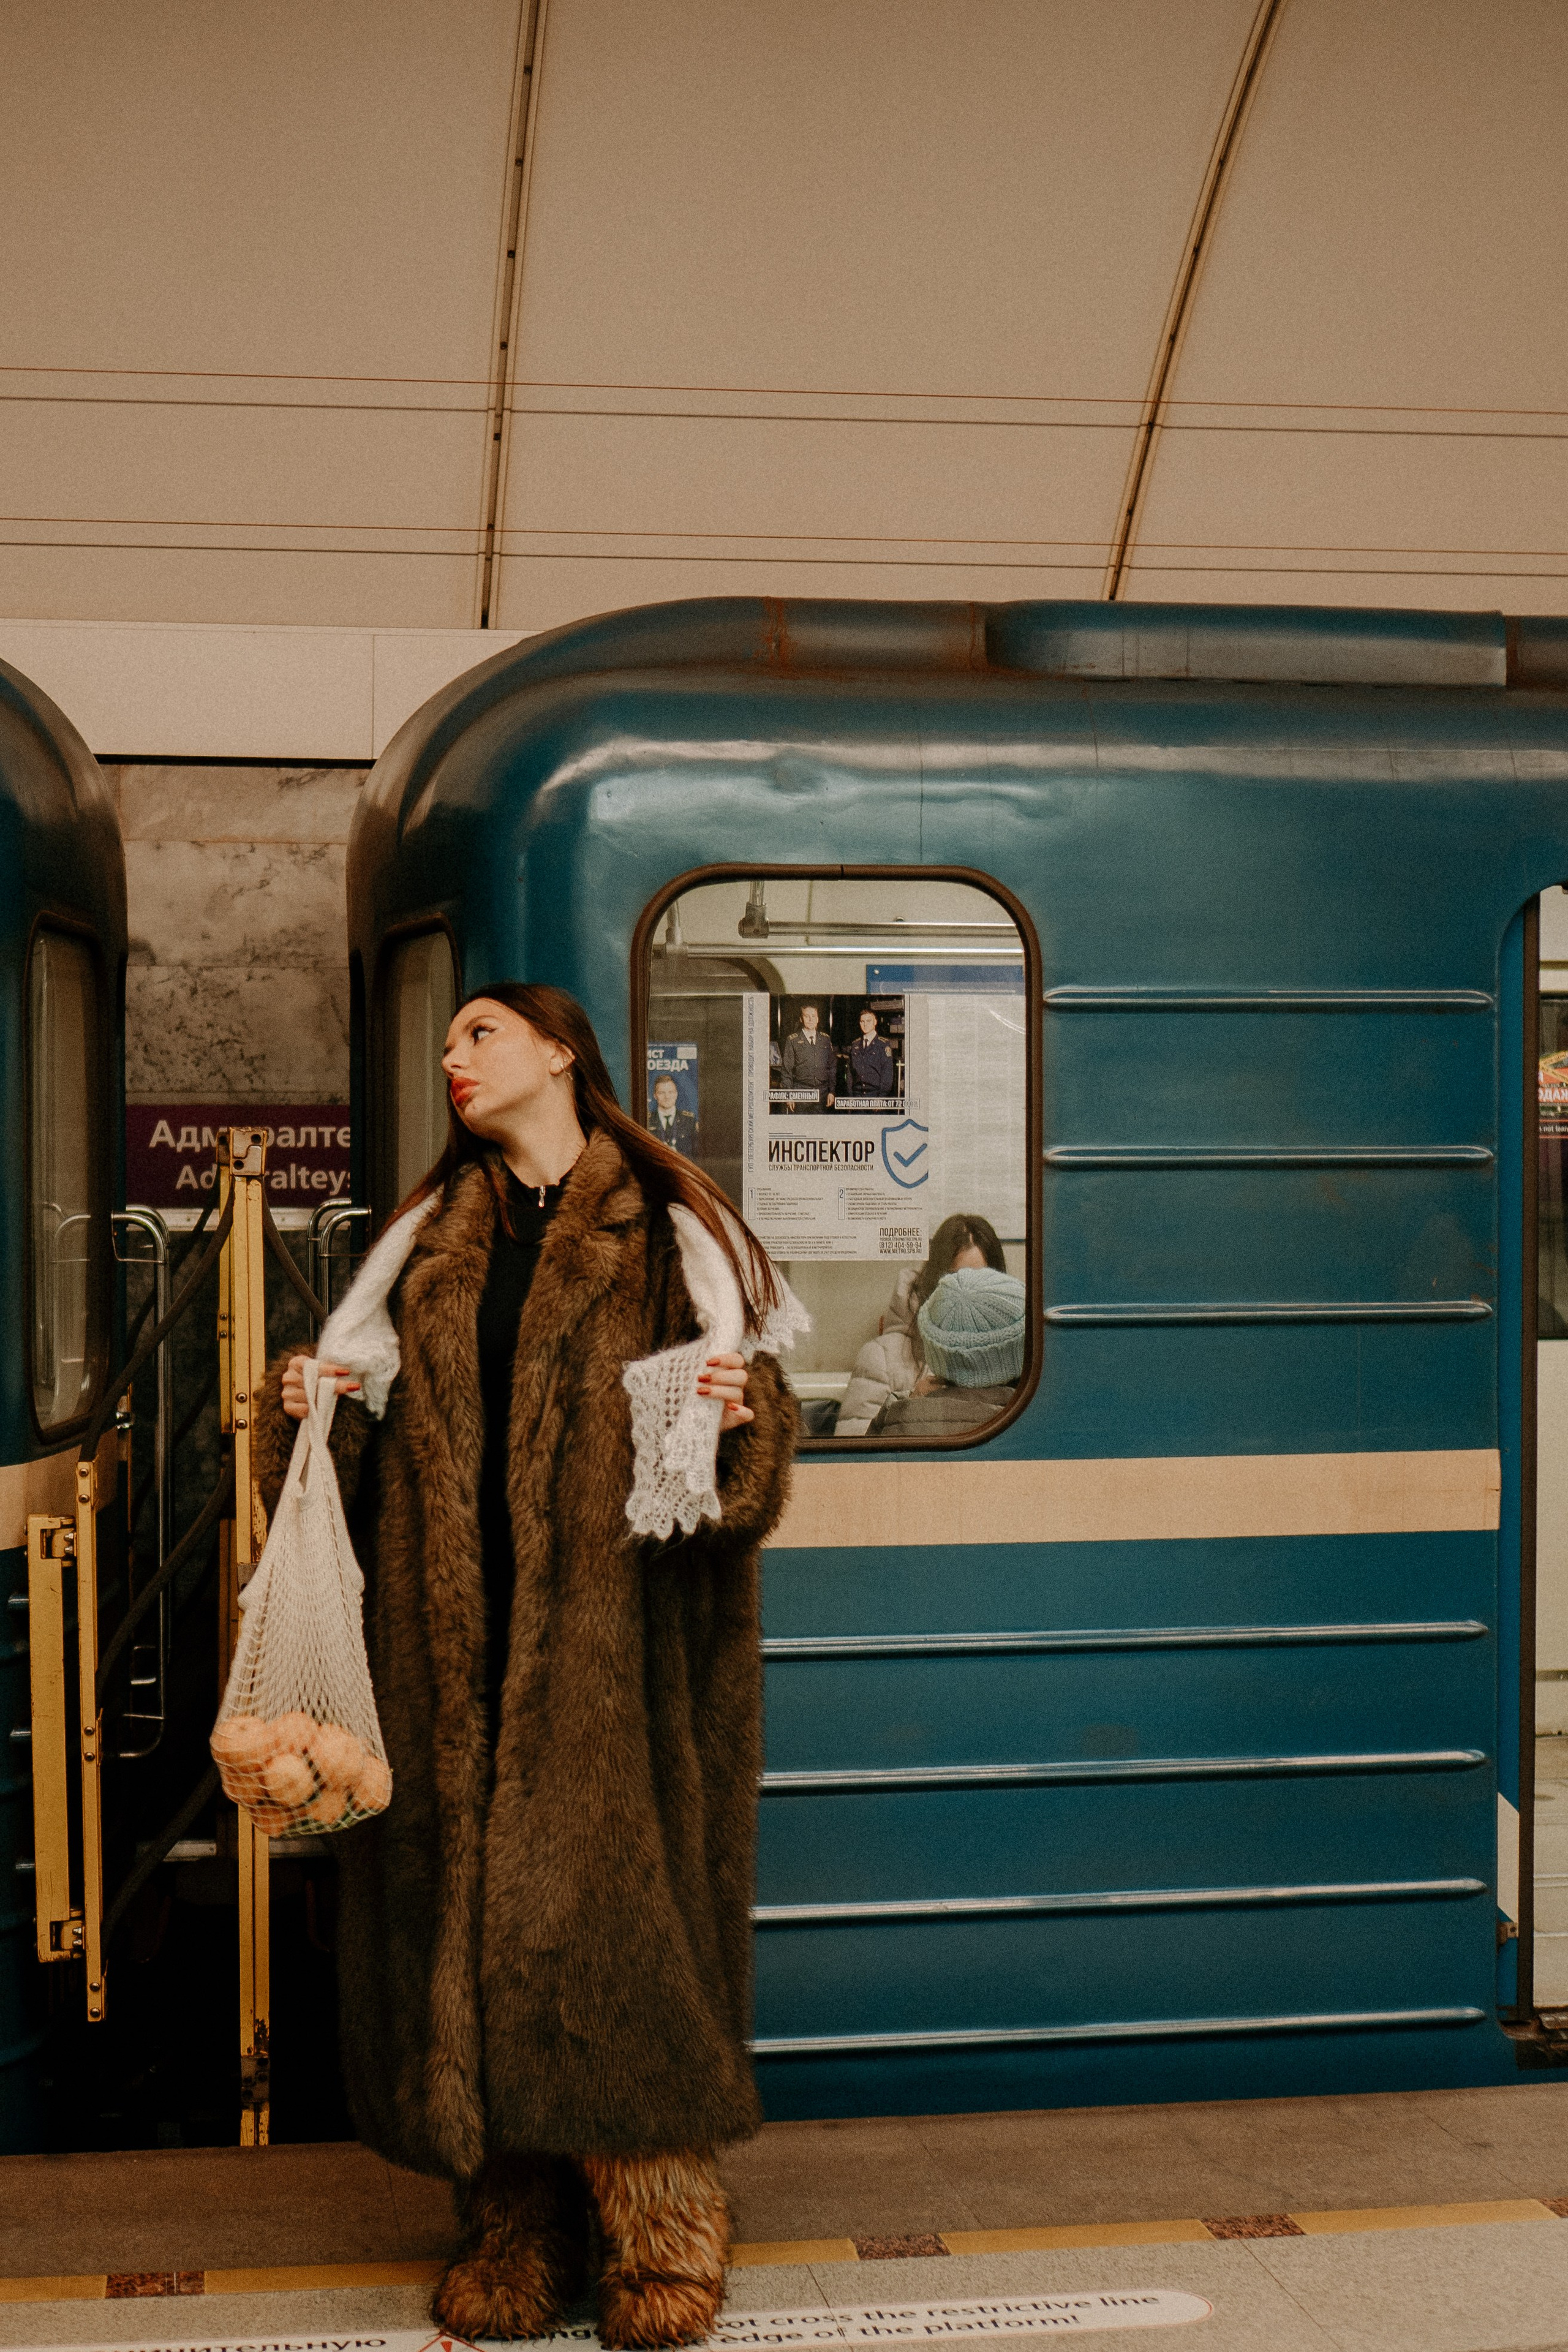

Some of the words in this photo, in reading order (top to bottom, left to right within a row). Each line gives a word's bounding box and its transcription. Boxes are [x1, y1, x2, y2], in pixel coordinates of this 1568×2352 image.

[790, 1090, 818, 1100] СМЕННЫЙ
[149, 1119, 350, 1153] Адмалте
[768, 1140, 875, 1163] ИНСПЕКТОР
[839, 1189, 844, 1199] 2
[880, 1227, 922, 1237] ПОДРОБНЕЕ:
[769, 2313, 853, 2326] cross
[863, 2309, 917, 2321] the
[927, 2299, 1092, 2317] restrictive
[1099, 2296, 1159, 2307] line
[720, 2332, 804, 2344] edge
[859, 2325, 914, 2337] the
[923, 2314, 1080, 2336] platform!
